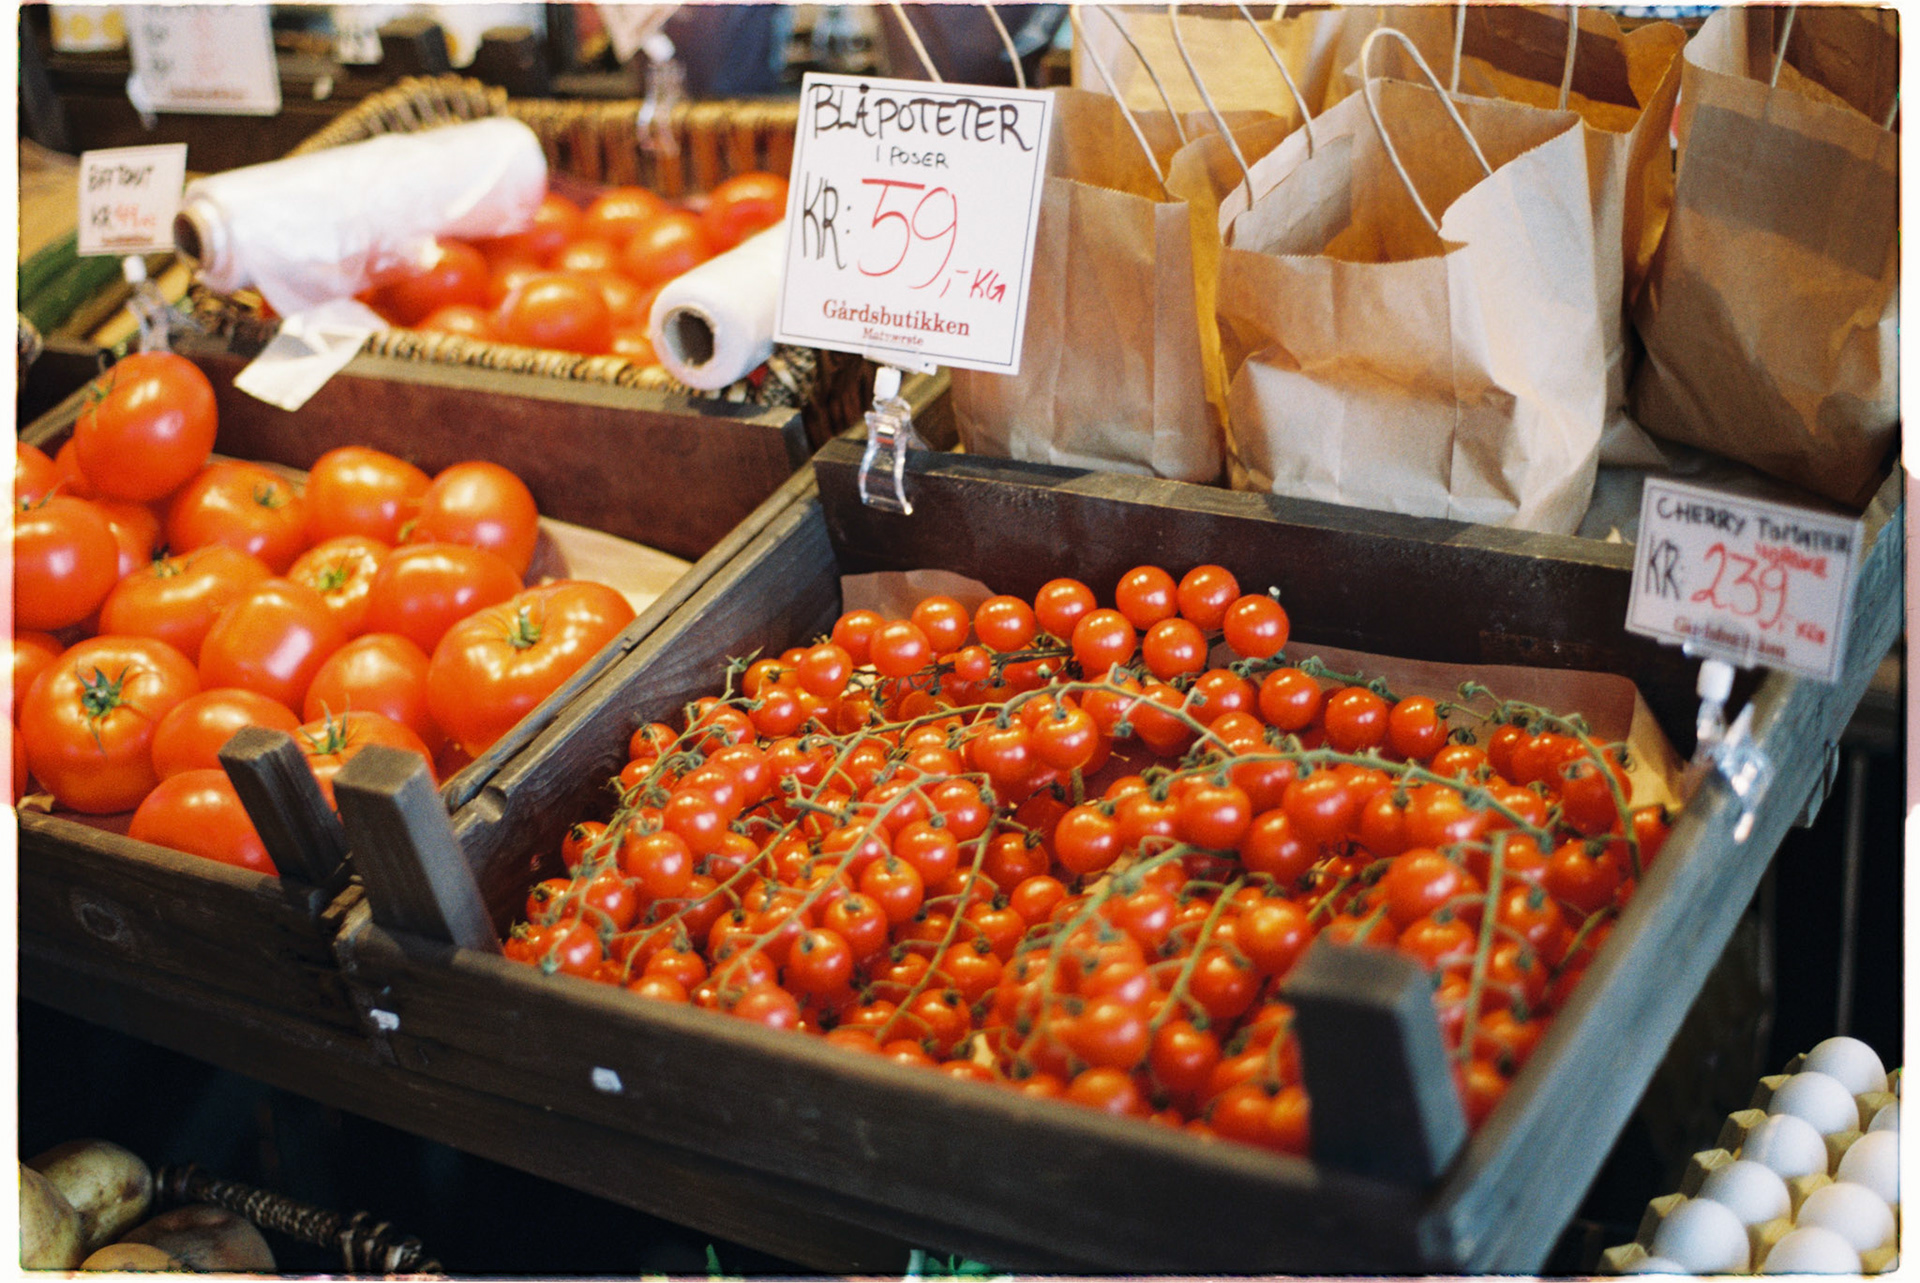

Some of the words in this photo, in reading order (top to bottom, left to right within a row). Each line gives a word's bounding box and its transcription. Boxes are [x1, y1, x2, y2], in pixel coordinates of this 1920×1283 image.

[807, 83, 1034, 152] BLÅPOTETER
[889, 146, 950, 169] POSER
[803, 171, 852, 270] KR:
[969, 267, 1007, 304] KG
[822, 298, 971, 337] Gårdsbutikken
[1656, 496, 1746, 536] CHERRY
